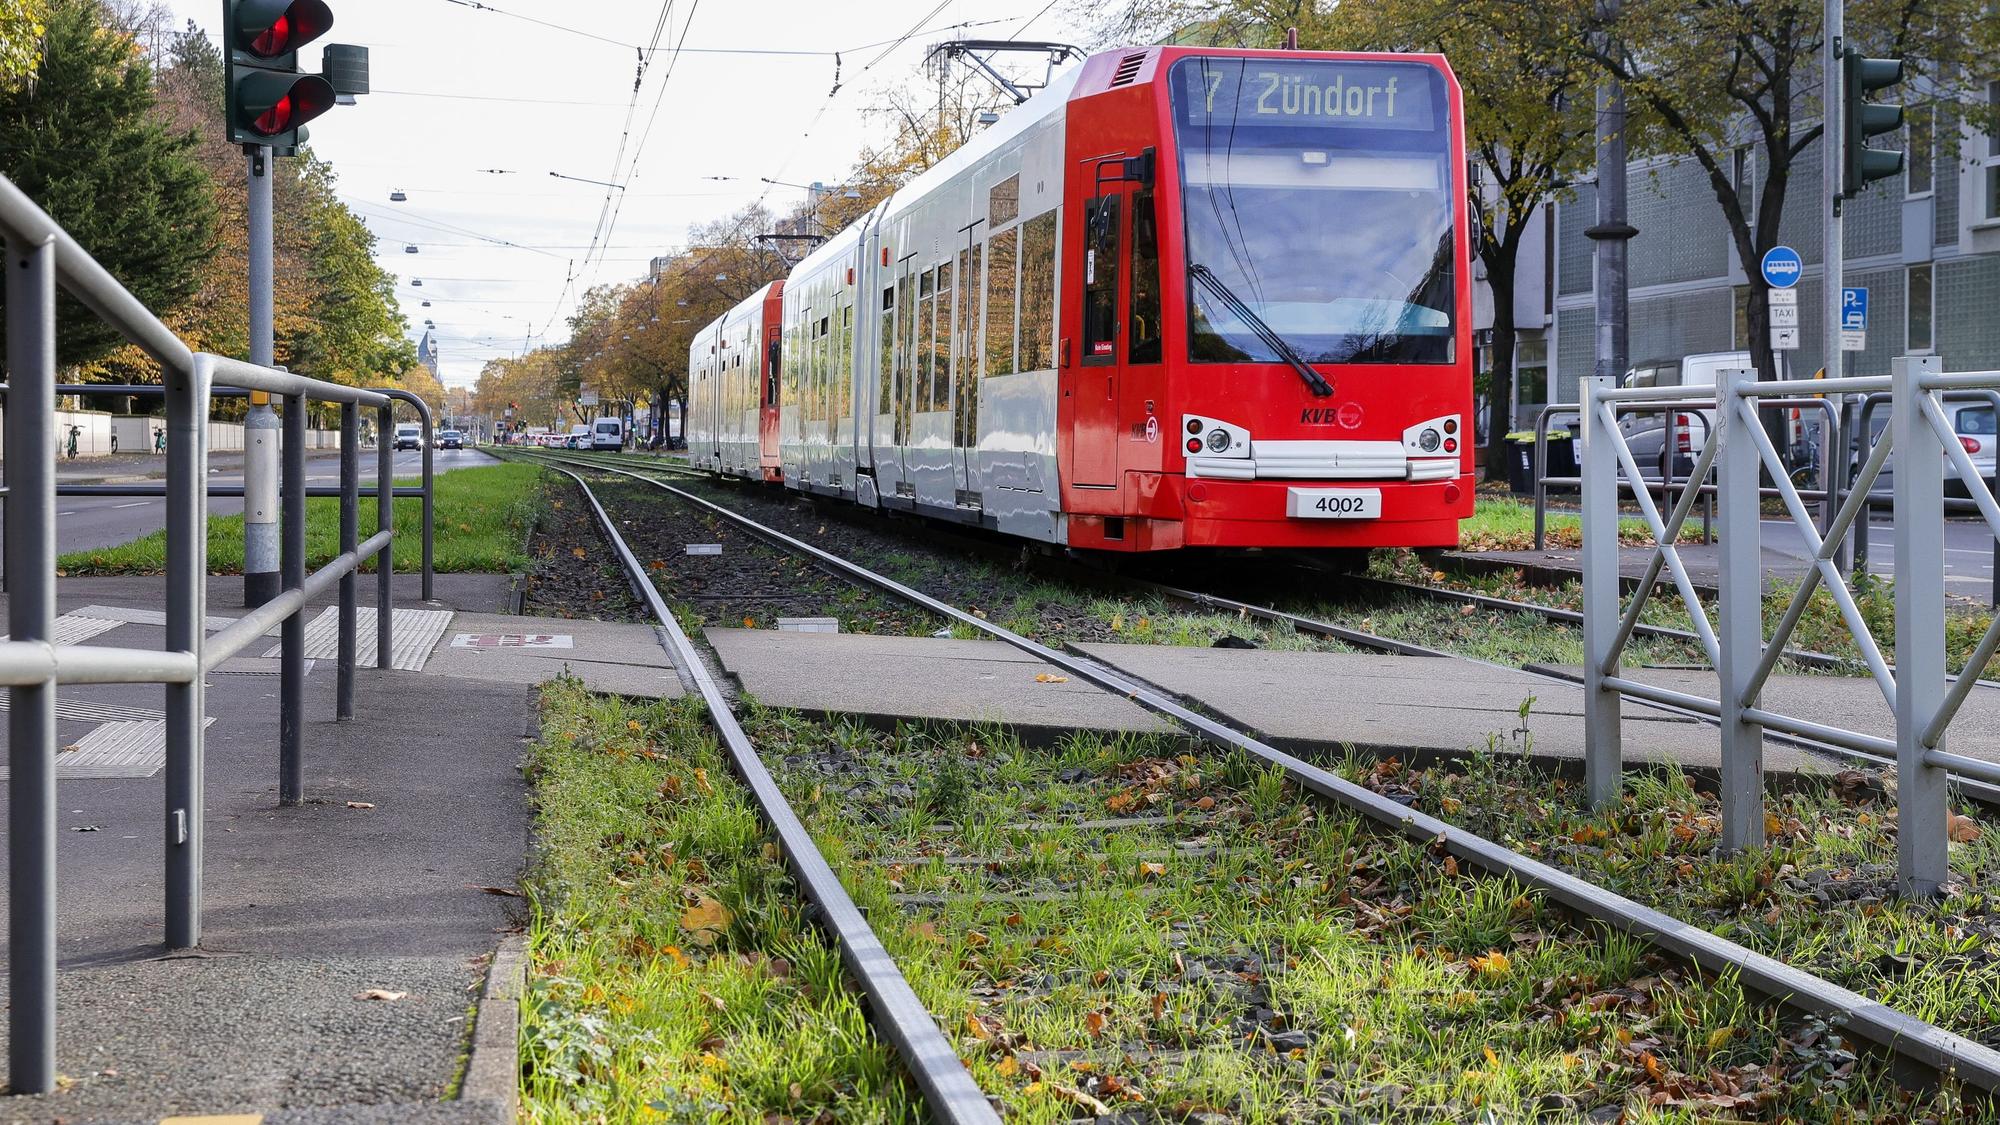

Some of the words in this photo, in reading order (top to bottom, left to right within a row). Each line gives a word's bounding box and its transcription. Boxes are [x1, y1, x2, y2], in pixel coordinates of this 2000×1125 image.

[1203, 71, 1224, 113] 7
[1257, 72, 1398, 117] Zündorf
[1844, 291, 1856, 307] P
[1774, 308, 1794, 318] TAXI
[1300, 408, 1337, 424] KVB
[1315, 497, 1364, 513] 4002
